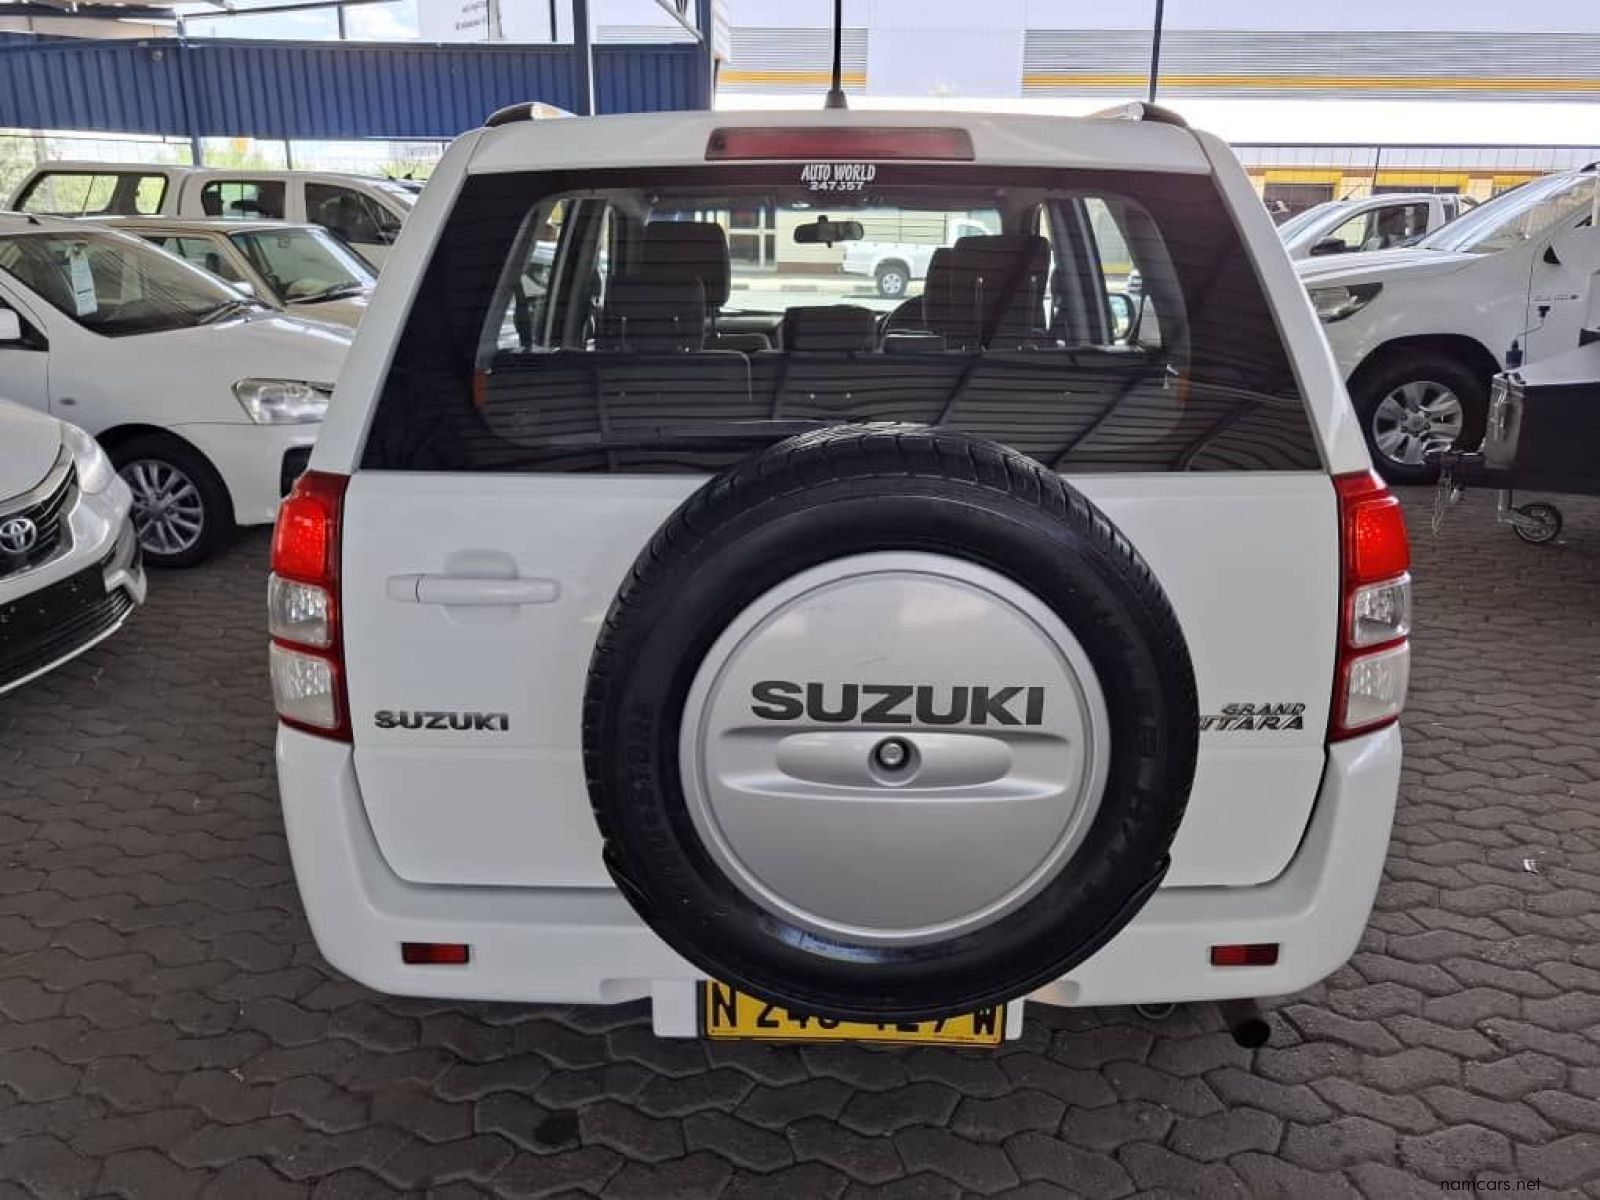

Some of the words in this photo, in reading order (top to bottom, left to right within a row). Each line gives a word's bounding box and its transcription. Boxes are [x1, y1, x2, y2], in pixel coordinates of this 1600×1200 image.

[801, 164, 831, 181] AUTO
[834, 164, 876, 181] WORLD
[752, 680, 1044, 725] SUZUKI
[1221, 702, 1306, 716] GRAND
[374, 710, 509, 731] SUZUKI
[1199, 714, 1304, 731] ITARA
[711, 981, 737, 1028] N
